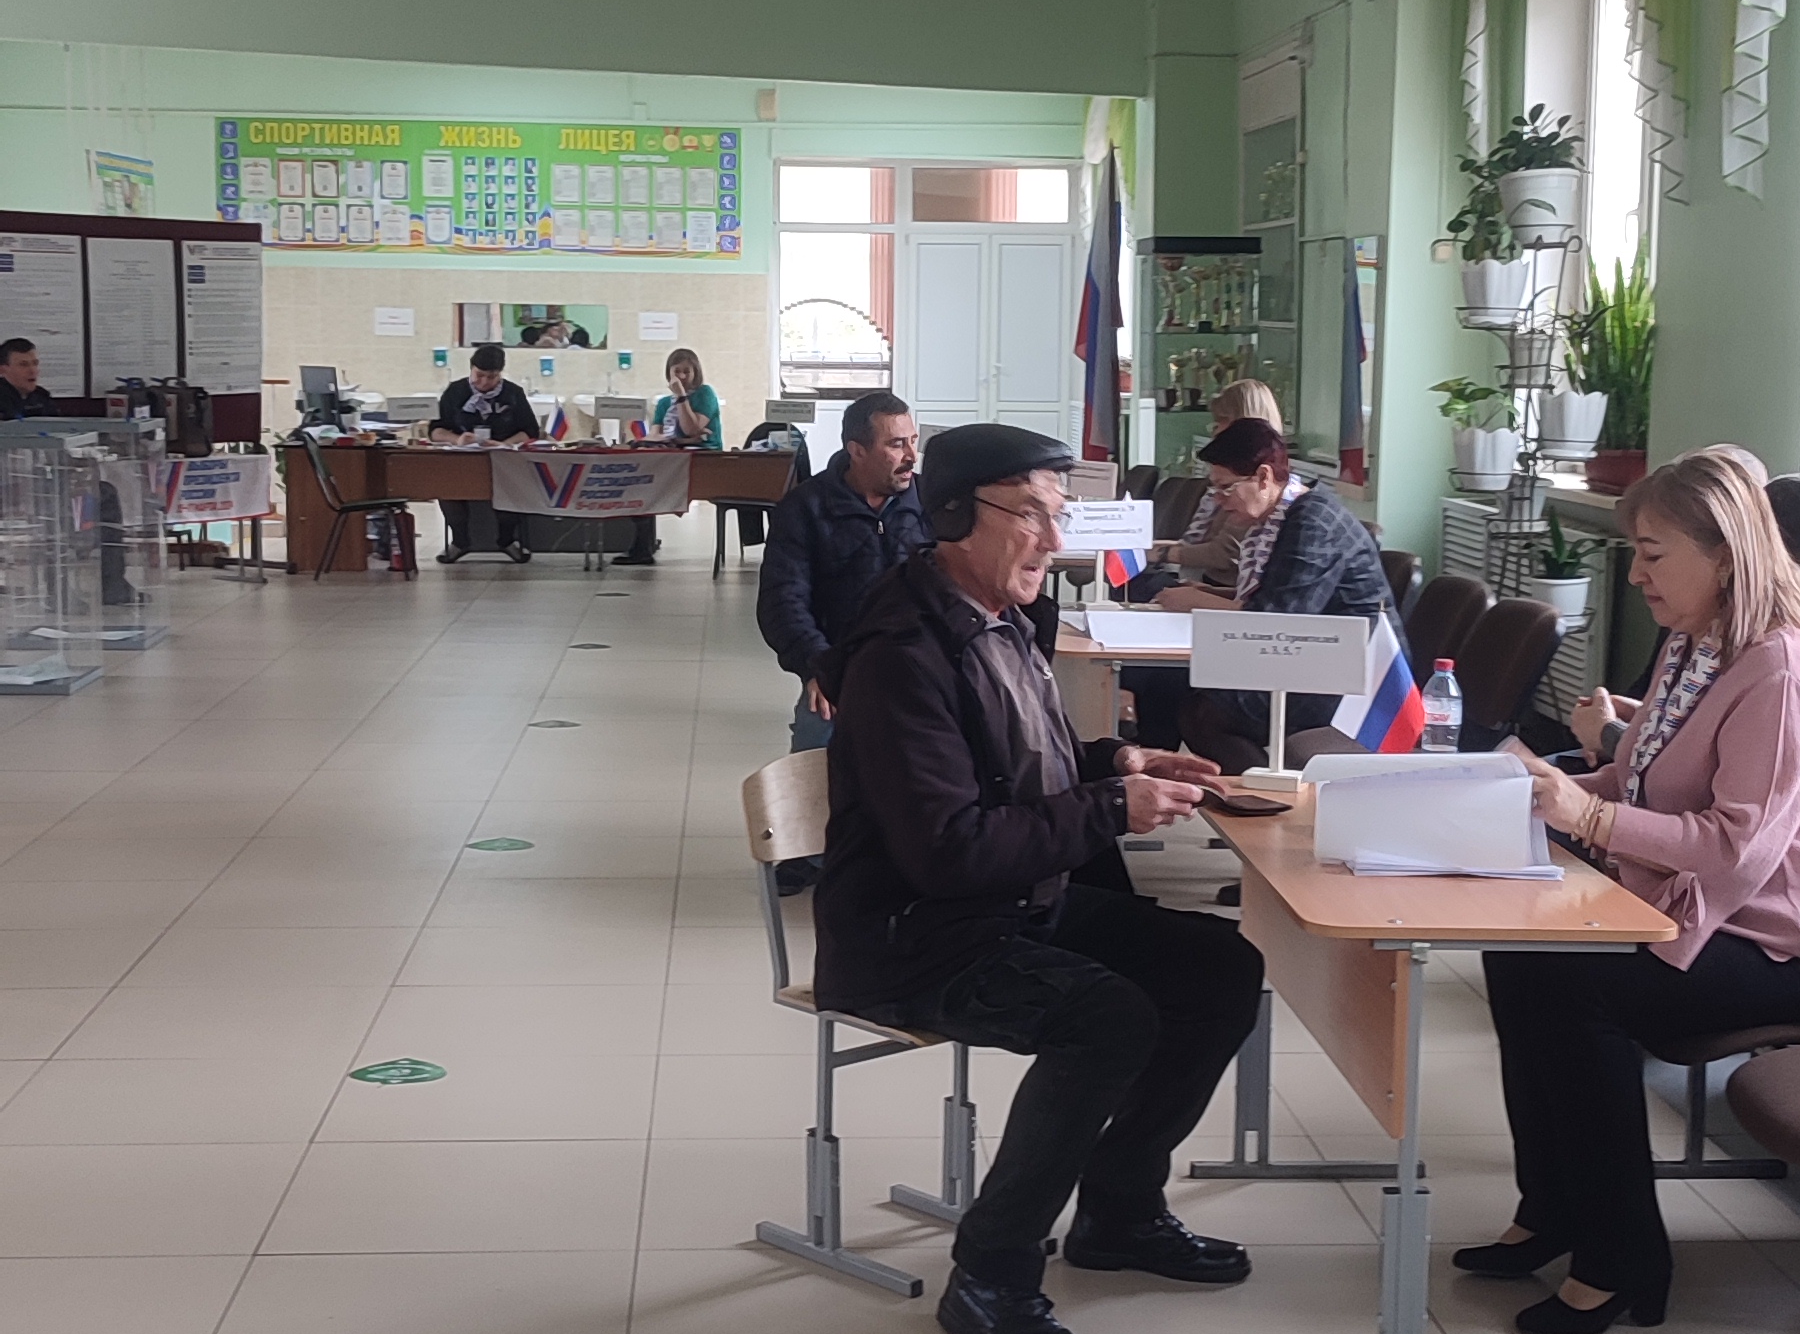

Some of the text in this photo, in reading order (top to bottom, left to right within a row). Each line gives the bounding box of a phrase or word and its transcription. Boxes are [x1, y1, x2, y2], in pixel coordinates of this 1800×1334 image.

[249, 122, 636, 154] СПОРТИВНАЯ ЖИЗНЬ ЛИЦЕЯ
[1222, 631, 1340, 644] ул. Аллея Строителей
[1295, 646, 1302, 655] 7
